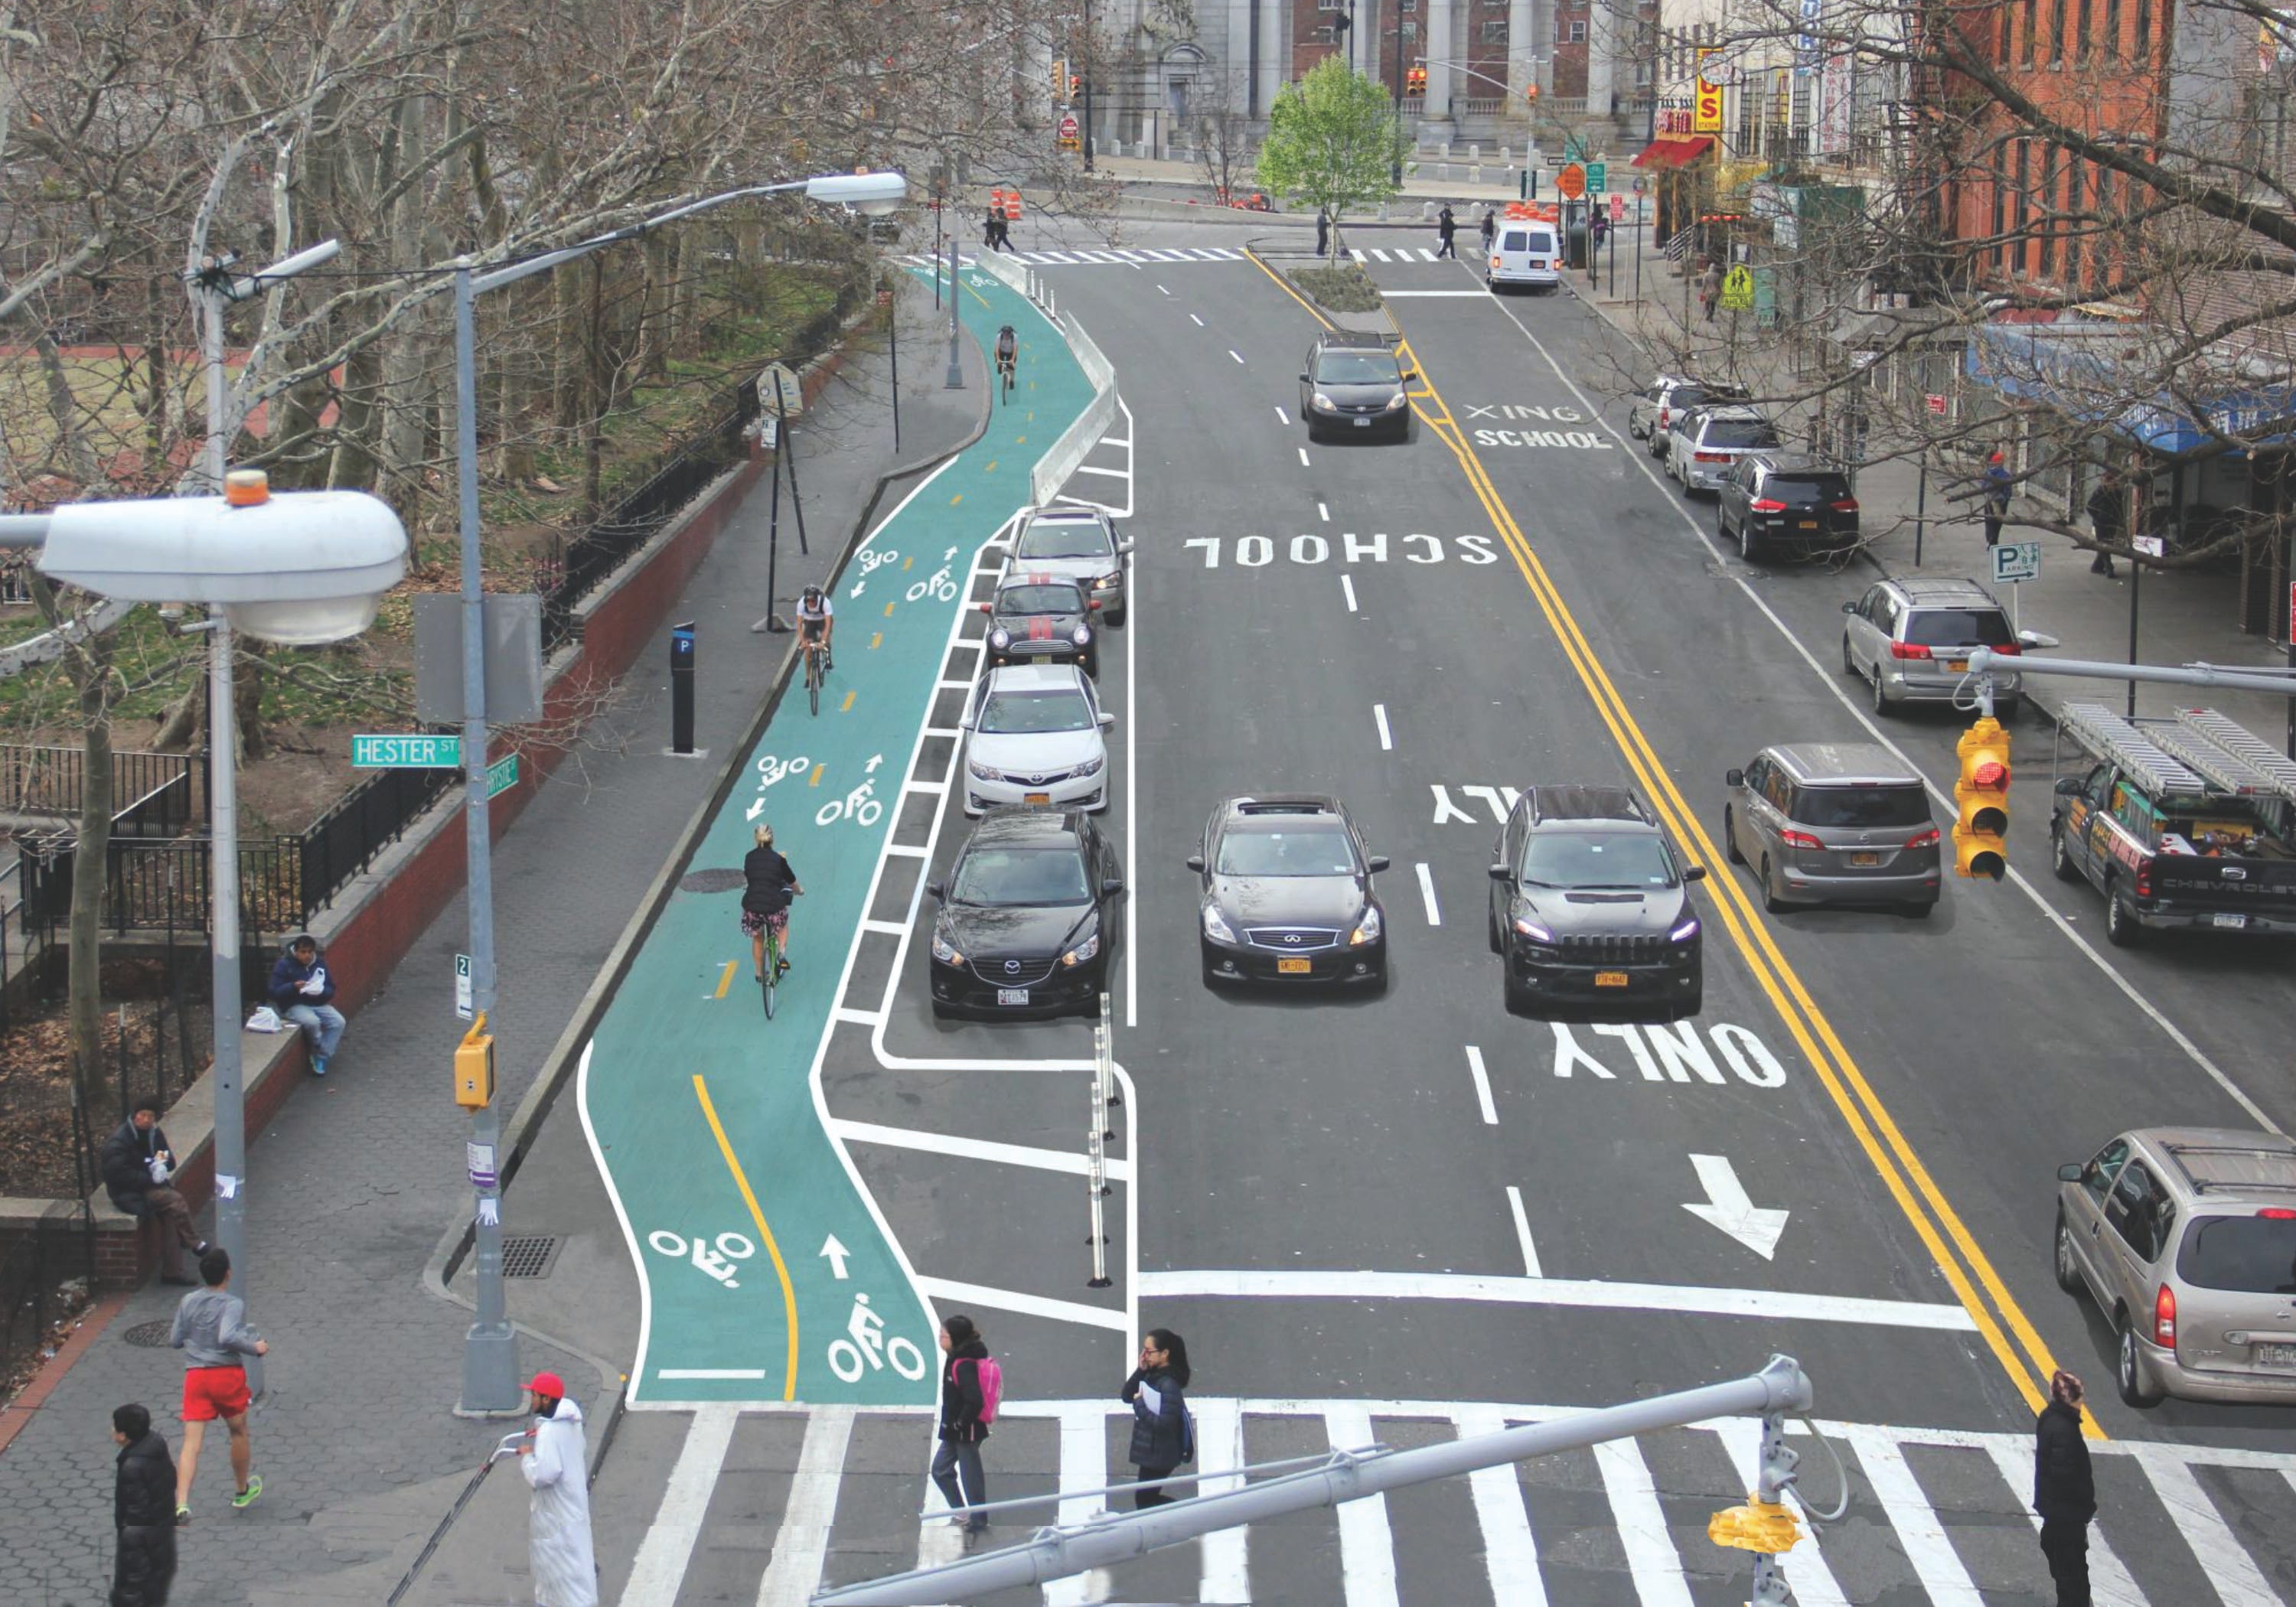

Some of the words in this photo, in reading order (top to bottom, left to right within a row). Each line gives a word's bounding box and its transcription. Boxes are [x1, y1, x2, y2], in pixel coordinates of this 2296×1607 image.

[1464, 404, 1582, 422] XING
[1474, 429, 1613, 450] SCHOOL
[1183, 533, 1499, 569] SCHOOL
[681, 641, 690, 652] P
[357, 739, 435, 763] HESTER
[440, 740, 456, 752] ST
[459, 958, 466, 974] 2
[1550, 1021, 1787, 1088] ONLY
